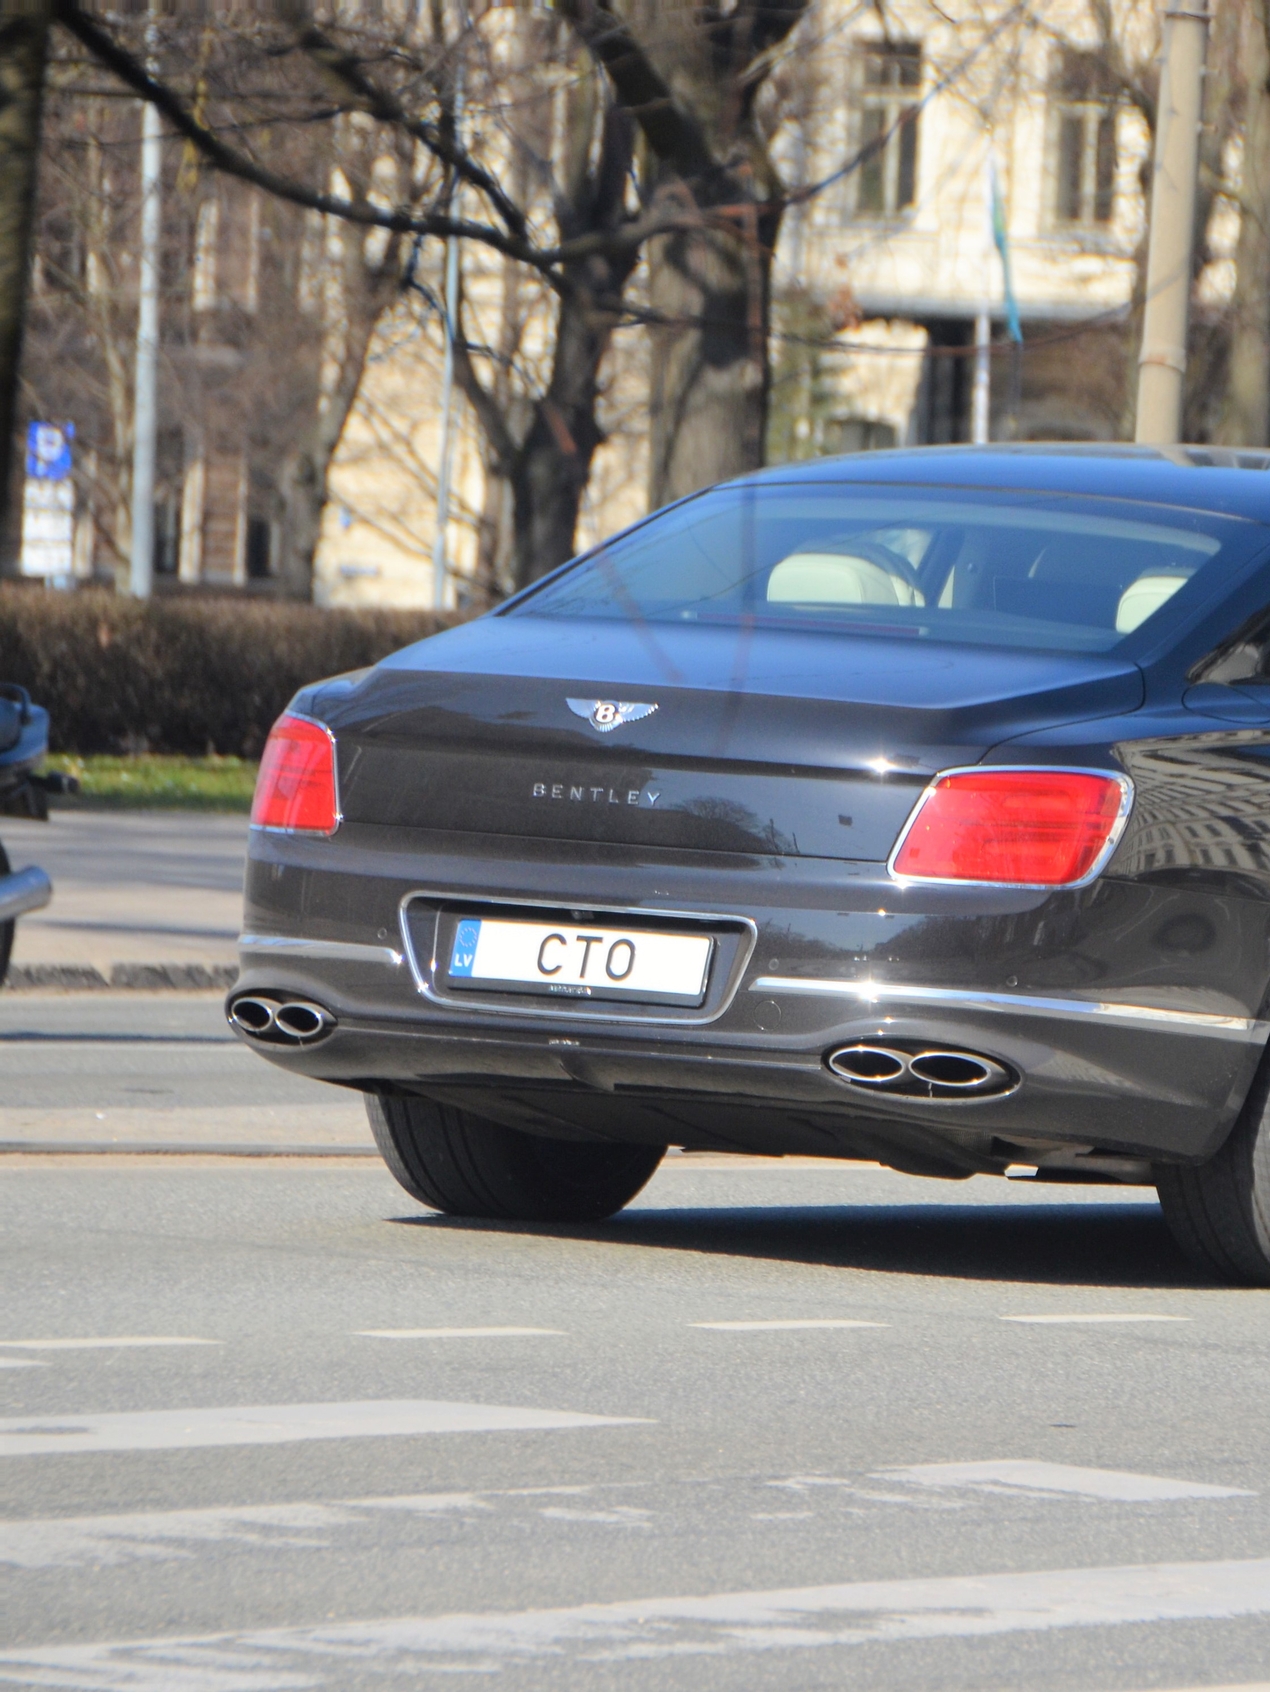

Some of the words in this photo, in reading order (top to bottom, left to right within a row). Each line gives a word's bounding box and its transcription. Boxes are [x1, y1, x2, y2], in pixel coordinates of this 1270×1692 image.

[533, 783, 660, 806] BENTLEY
[454, 952, 473, 968] LV
[536, 933, 637, 982] CTO
